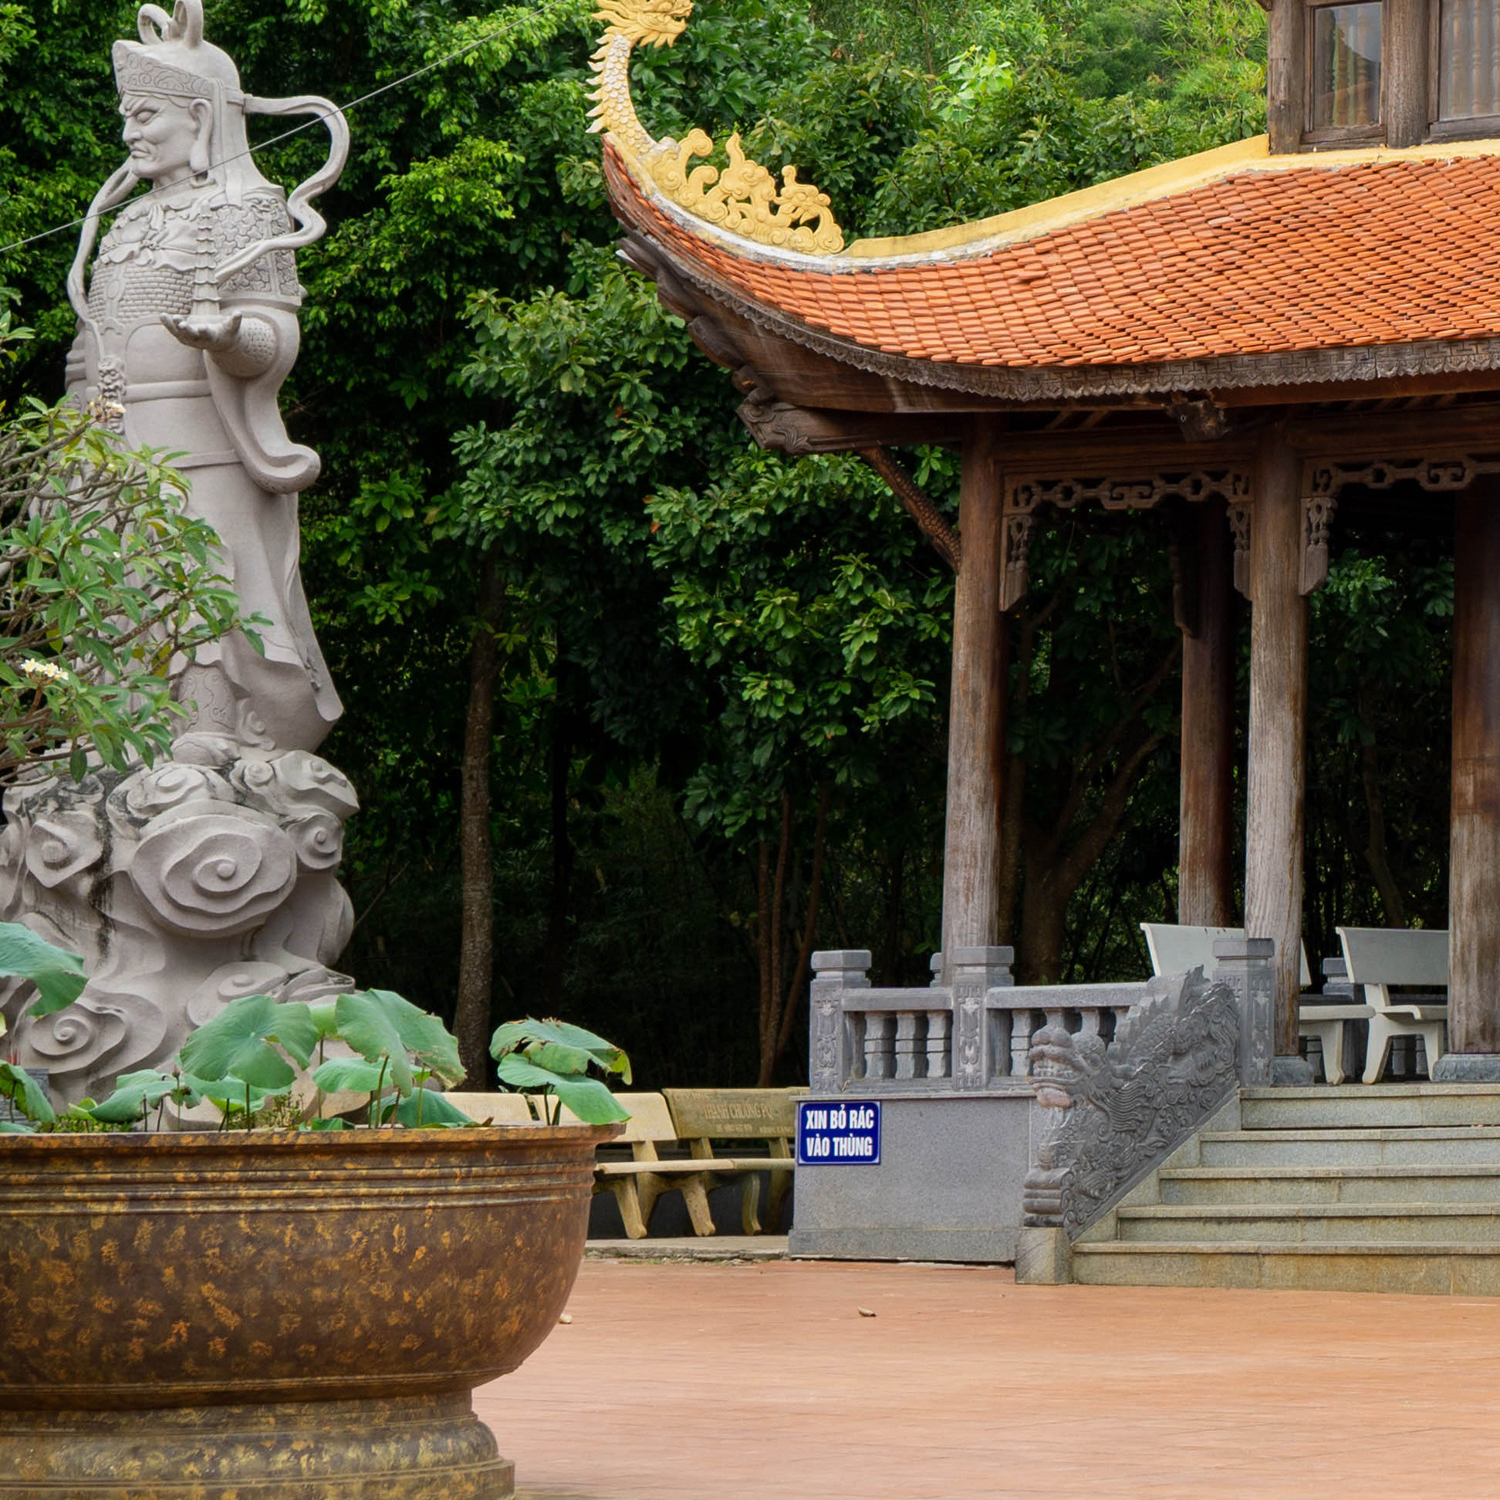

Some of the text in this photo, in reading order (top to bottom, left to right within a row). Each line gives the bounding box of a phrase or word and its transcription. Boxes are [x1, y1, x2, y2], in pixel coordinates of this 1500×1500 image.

[806, 1104, 874, 1129] XIN BỎ RÁC
[807, 1133, 872, 1156] VÀO THÙNG
